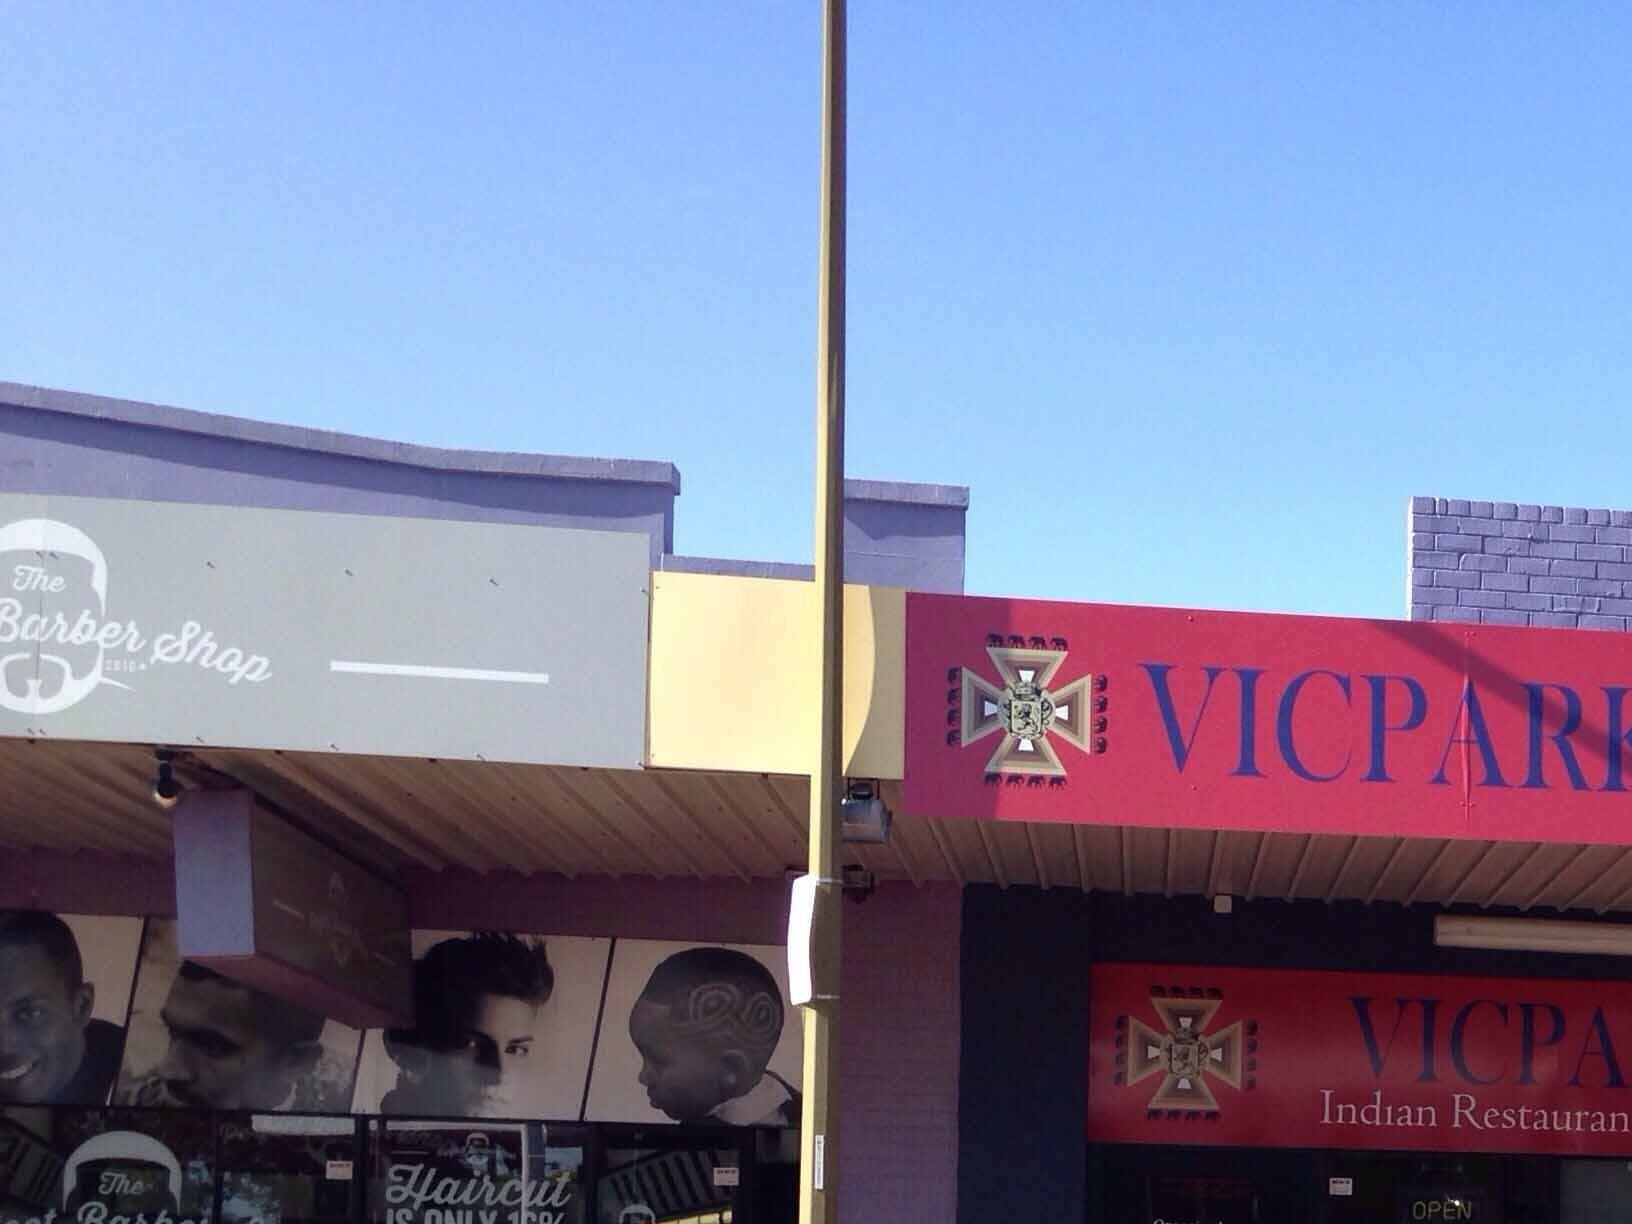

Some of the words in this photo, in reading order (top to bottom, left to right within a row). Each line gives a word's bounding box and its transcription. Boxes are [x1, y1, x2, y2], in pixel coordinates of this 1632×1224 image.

[13, 565, 66, 592] The
[0, 597, 147, 652] Barber
[150, 621, 272, 684] Shop
[1320, 1089, 1438, 1128] Indian
[98, 1171, 146, 1197] The
[386, 1163, 571, 1210] Haircut
[1413, 1200, 1472, 1220] OPEN
